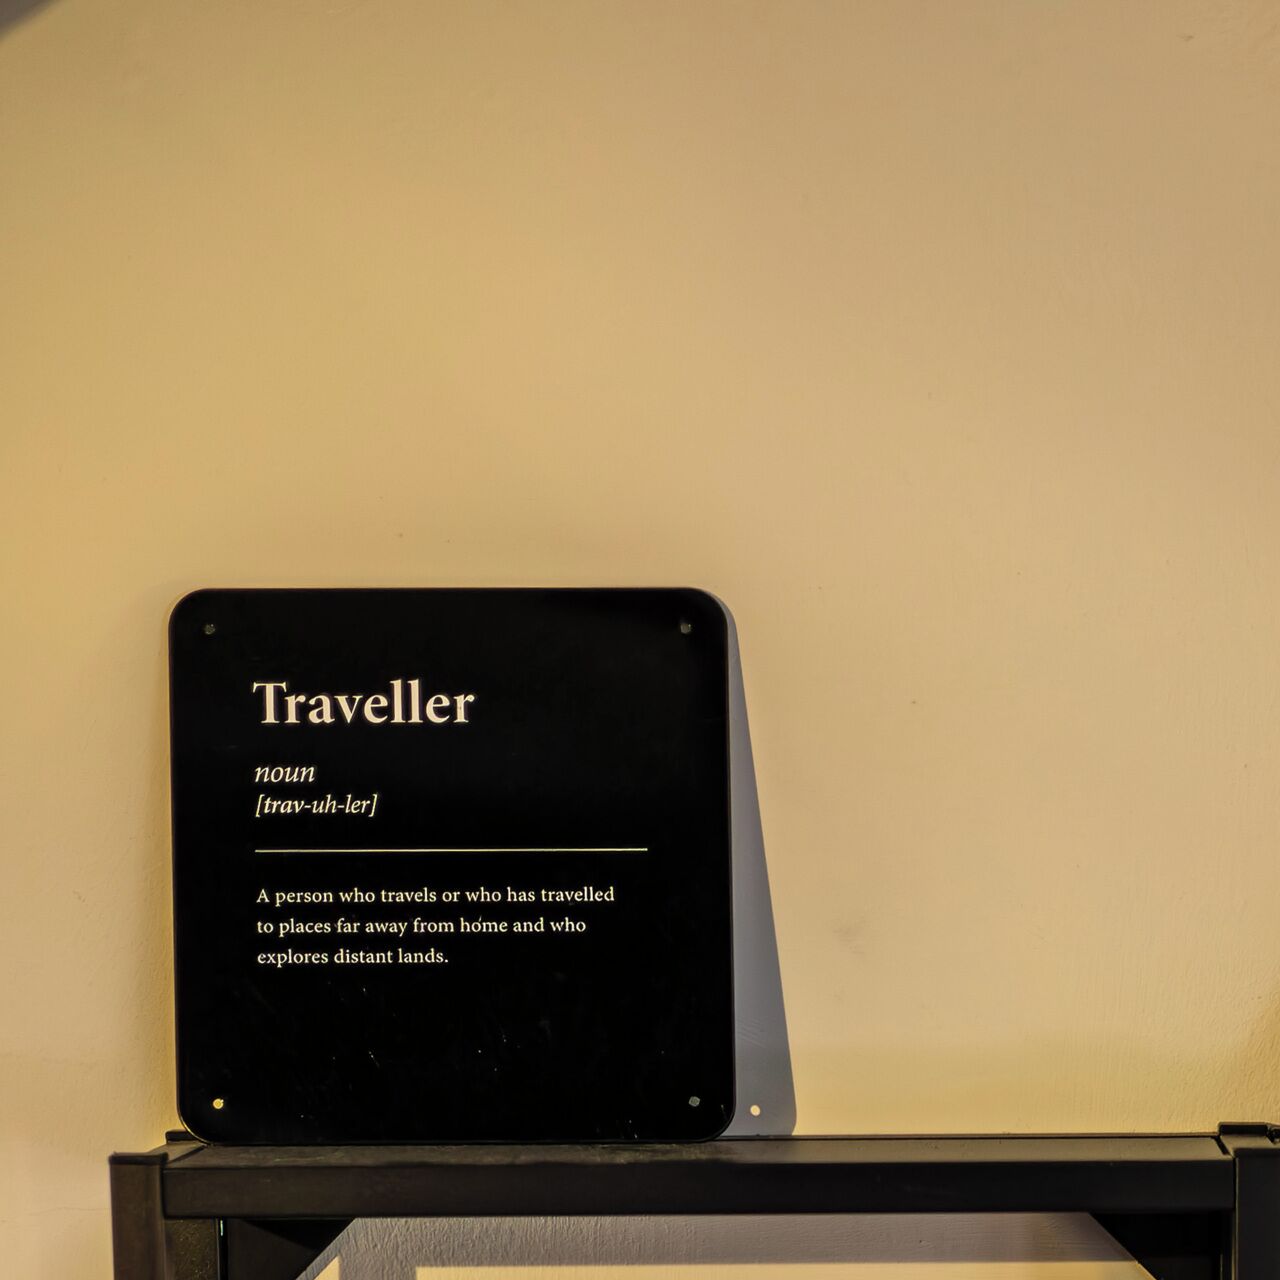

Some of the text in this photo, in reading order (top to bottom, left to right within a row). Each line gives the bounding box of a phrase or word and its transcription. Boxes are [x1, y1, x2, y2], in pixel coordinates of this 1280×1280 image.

[253, 679, 475, 724] Traveller
[254, 764, 315, 783] noun
[256, 793, 377, 817] [trav-uh-ler]
[257, 886, 614, 908] A person who travels or who has travelled
[257, 916, 586, 937] to places far away from home and who
[257, 947, 449, 968] explores distant lands.
